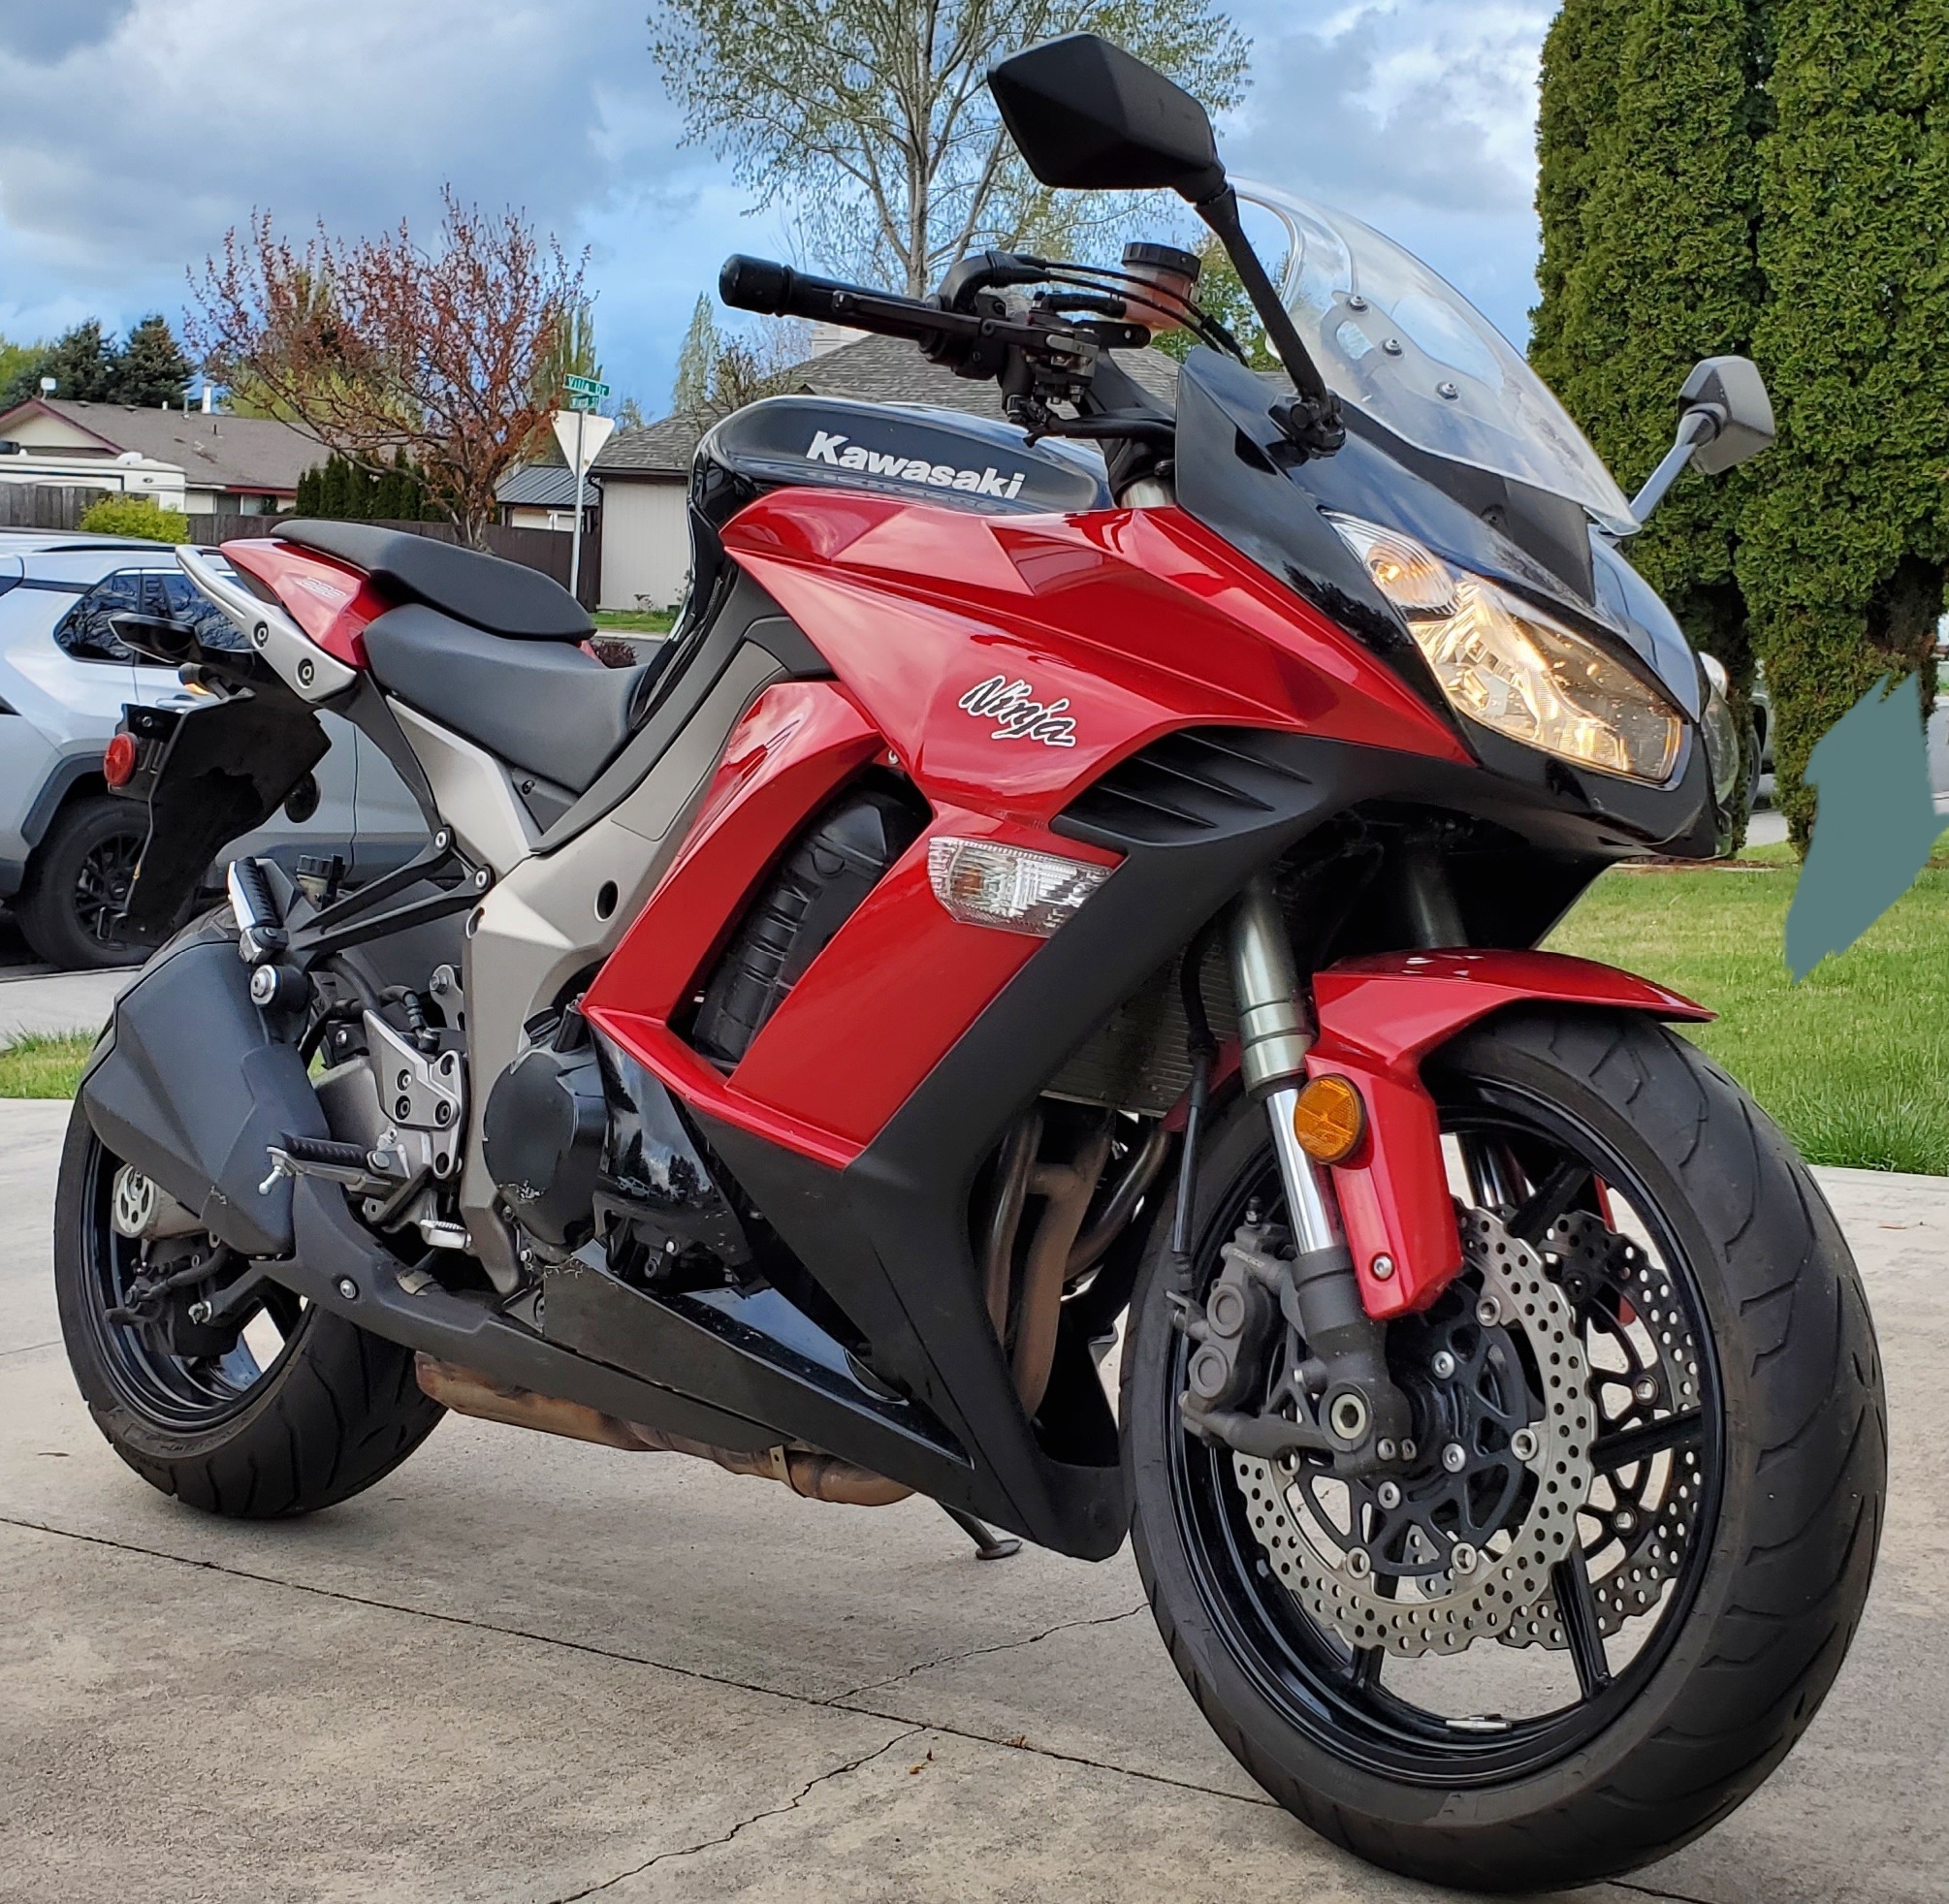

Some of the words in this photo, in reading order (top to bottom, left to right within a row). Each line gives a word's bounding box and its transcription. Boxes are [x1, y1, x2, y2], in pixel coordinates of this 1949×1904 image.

[595, 383, 607, 397] Dr
[806, 429, 1026, 499] Kawasaki
[958, 675, 1076, 747] Ninja
